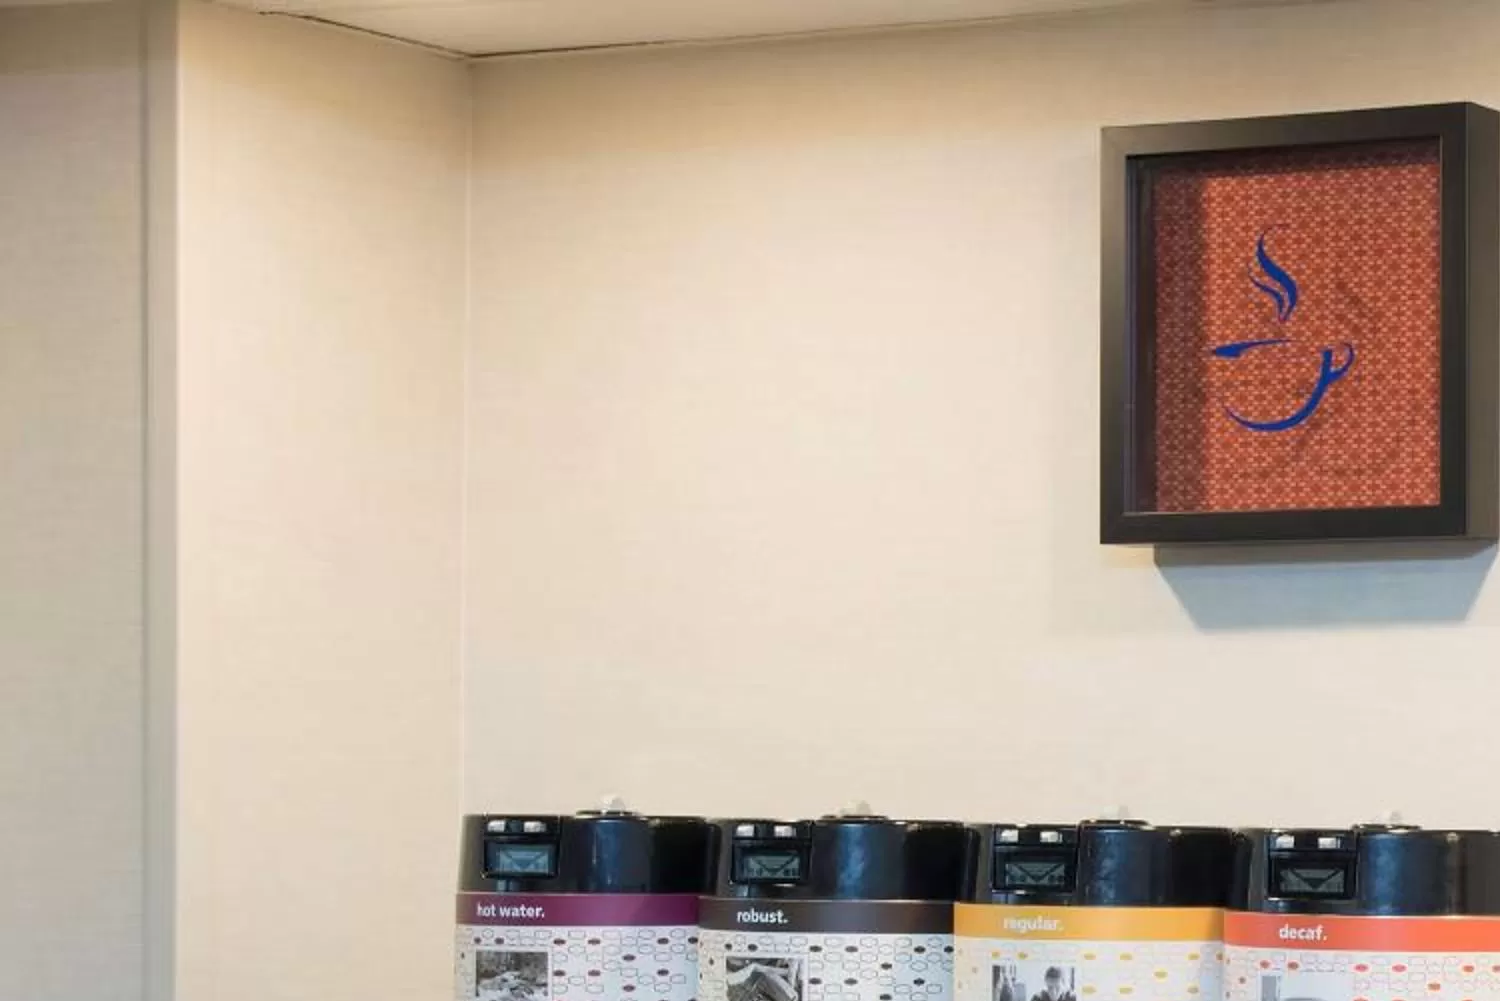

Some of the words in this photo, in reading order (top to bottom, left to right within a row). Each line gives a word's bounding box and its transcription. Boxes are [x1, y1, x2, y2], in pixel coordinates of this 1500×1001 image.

[477, 903, 496, 916] hot
[500, 904, 545, 918] water.
[737, 908, 788, 924] robust.
[1279, 923, 1327, 940] decaf.
